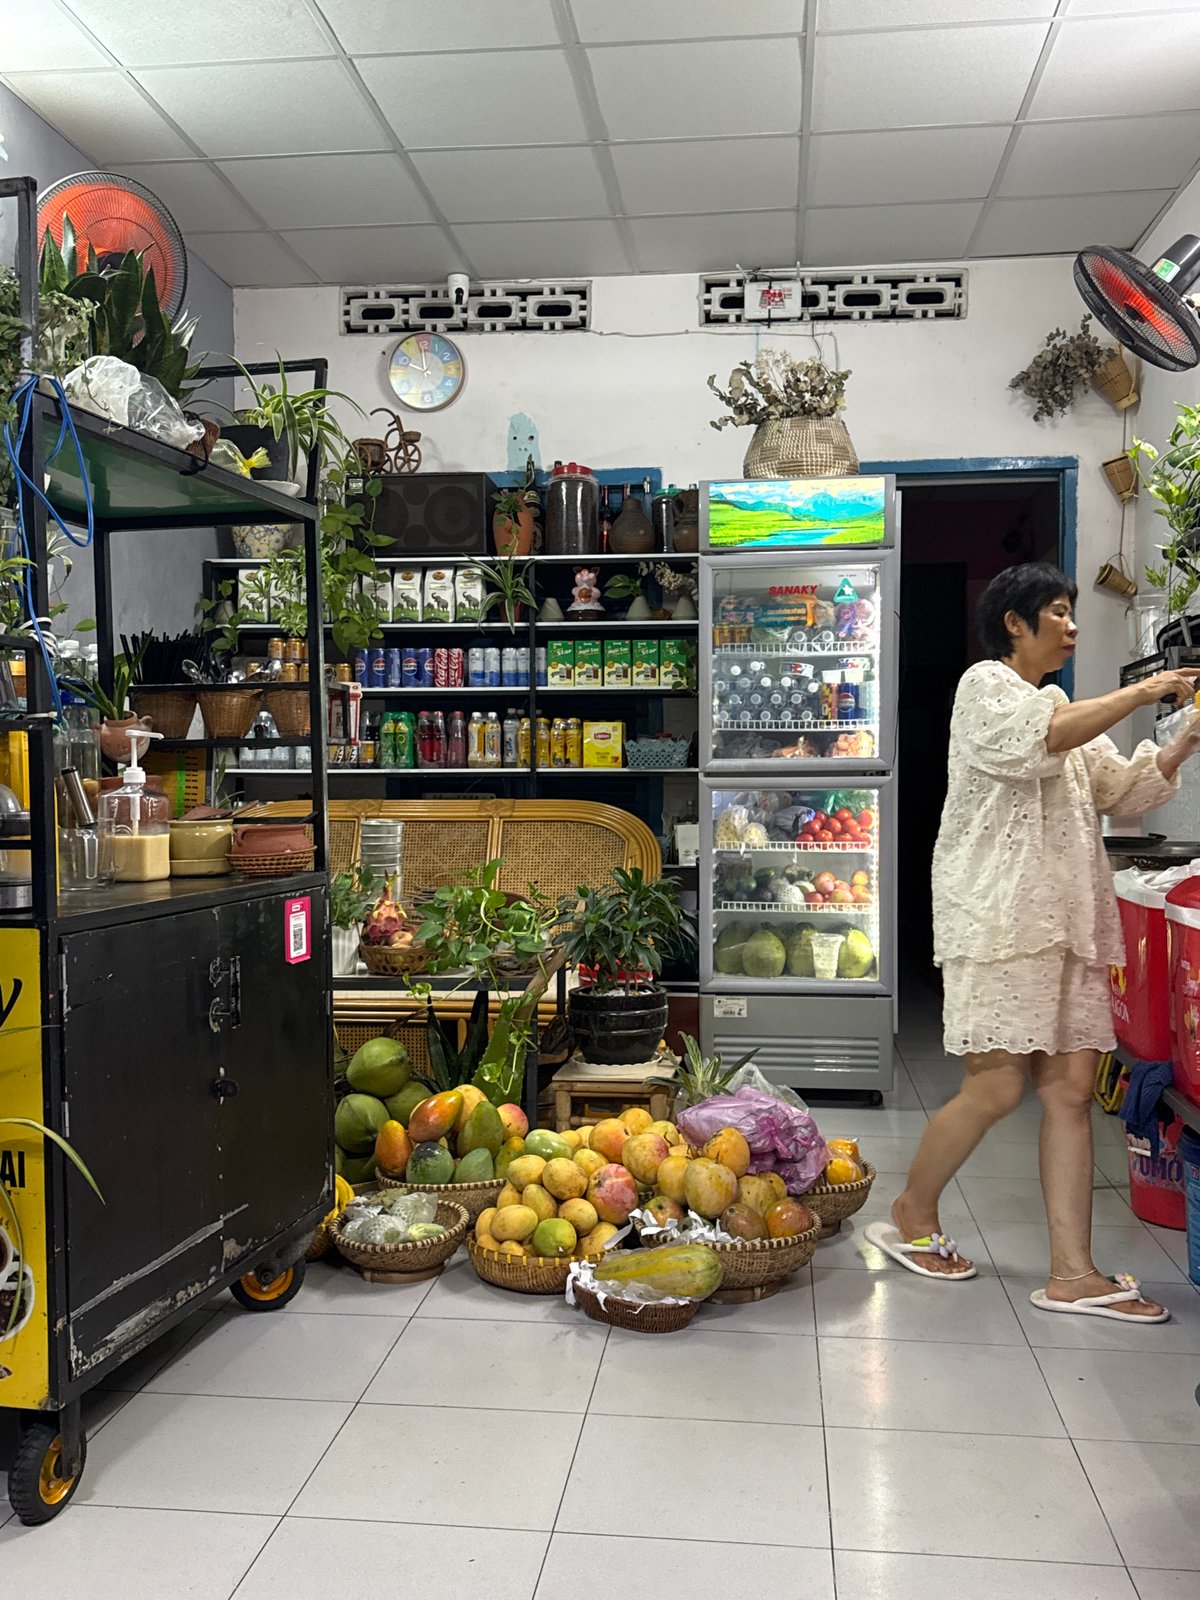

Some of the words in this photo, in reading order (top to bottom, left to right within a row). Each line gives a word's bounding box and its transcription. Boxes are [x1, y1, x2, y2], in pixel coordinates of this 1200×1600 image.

[399, 356, 409, 364] 10
[448, 365, 455, 374] 3
[424, 393, 432, 402] 6
[768, 585, 818, 595] SANAKY
